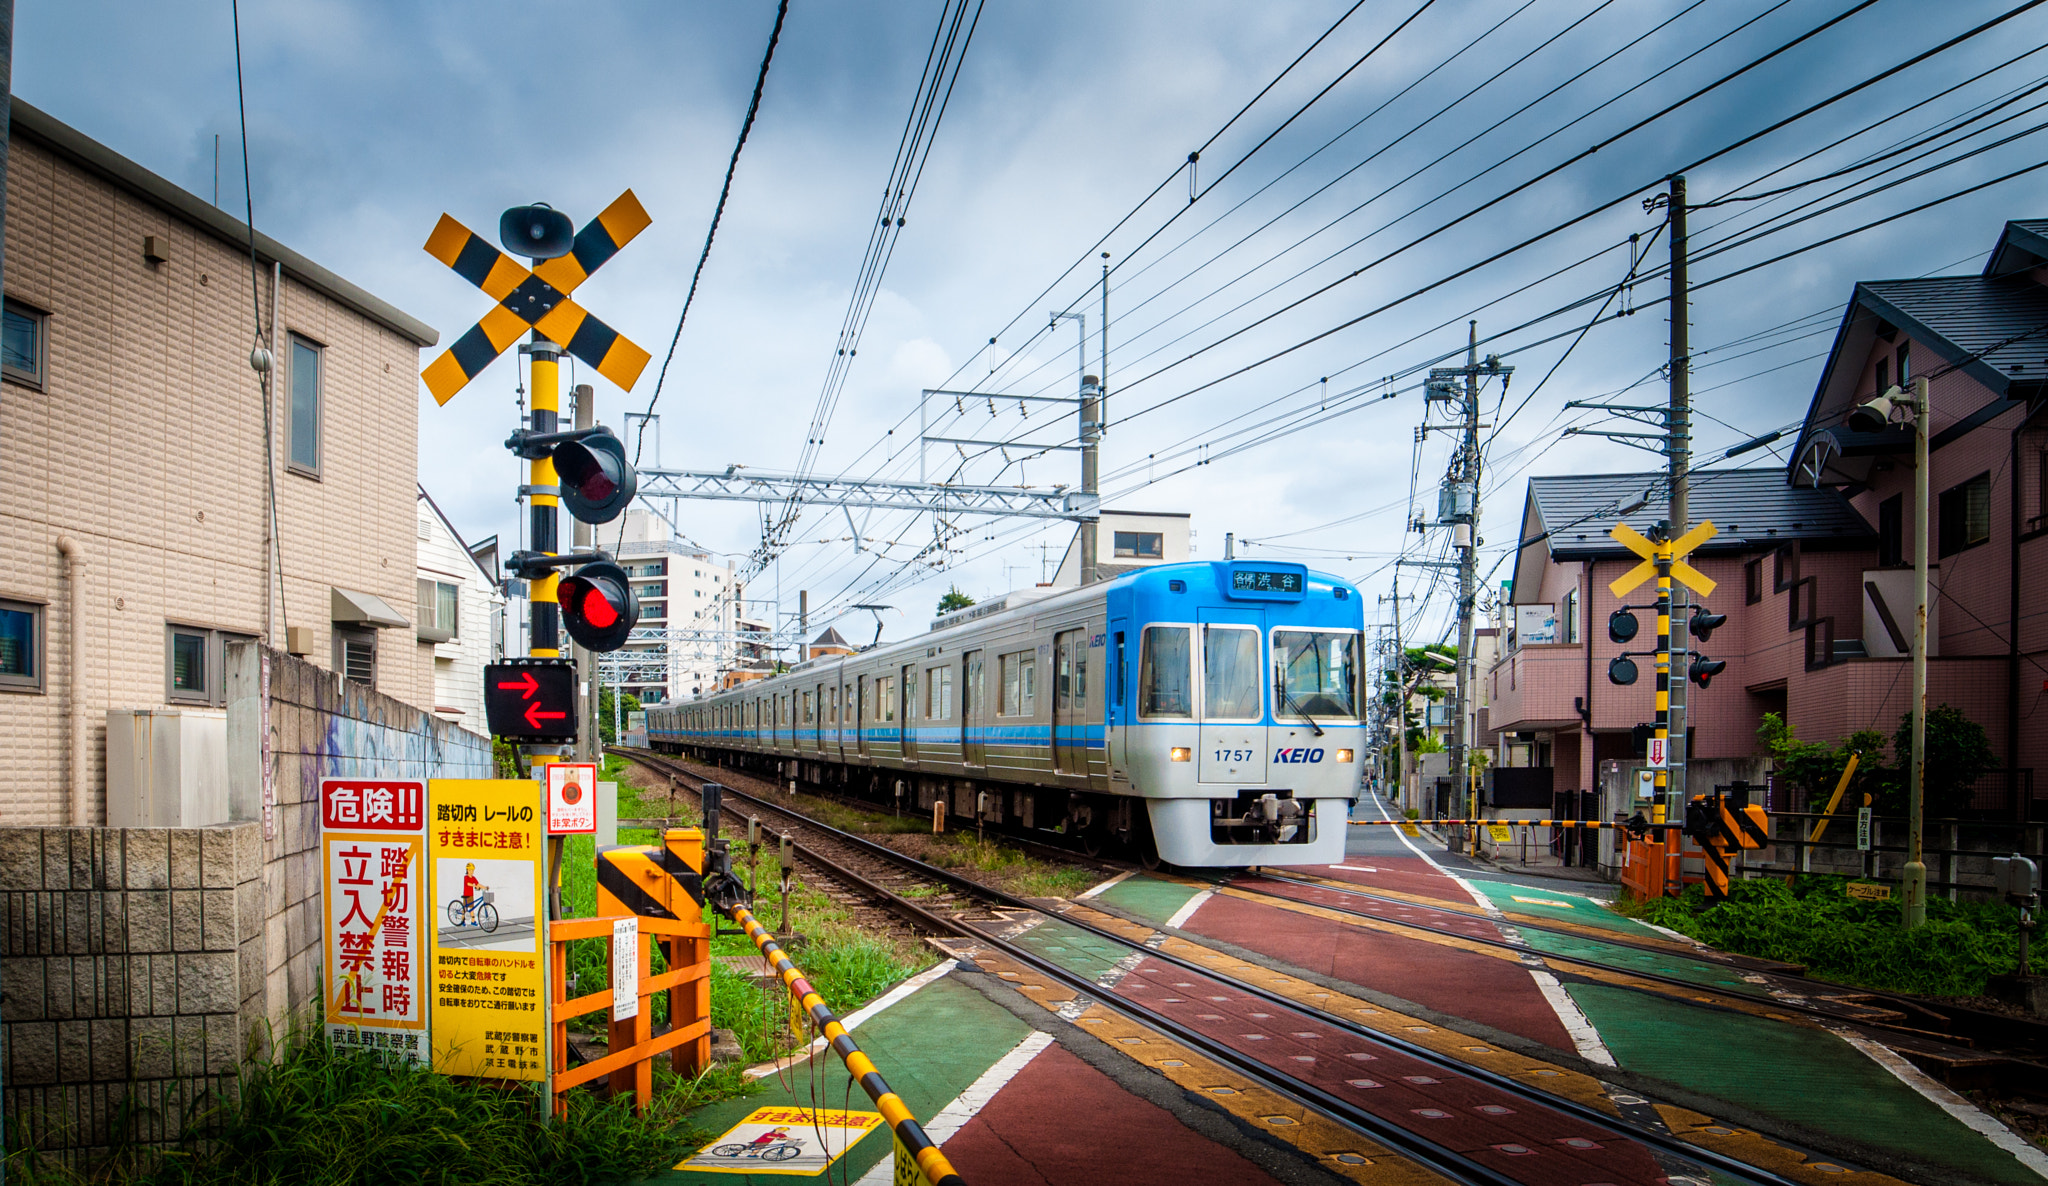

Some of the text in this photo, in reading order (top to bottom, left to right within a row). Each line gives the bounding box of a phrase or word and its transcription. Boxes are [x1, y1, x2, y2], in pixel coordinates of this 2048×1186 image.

[1258, 573, 1295, 588] 渋谷
[1089, 633, 1106, 648] KEIO
[1215, 749, 1253, 762] 1757
[1273, 748, 1324, 764] KEIO
[329, 787, 417, 824] 危険!!
[437, 803, 533, 822] 踏切内 レールの
[551, 817, 593, 828] 非常ボタン
[1859, 812, 1869, 846] 前方注意
[438, 828, 530, 849] すきまに注意!
[1848, 885, 1888, 898] ケーブル注意
[338, 845, 376, 1015] 立入禁止
[380, 847, 411, 1016] 踏切警報時
[438, 955, 536, 969] 踏切内で自転車のハンドルを
[438, 969, 507, 982] 切ると大変危険です
[438, 983, 536, 997] 安全確保のため、この踏切では
[439, 997, 536, 1012] 自転車をおりてご通行願います
[332, 1028, 419, 1050] 武蔵野警察署
[485, 1030, 538, 1043] 武蔵野警察署
[485, 1044, 538, 1057] 武蔵野市
[750, 1111, 881, 1128] すきまに注意!
